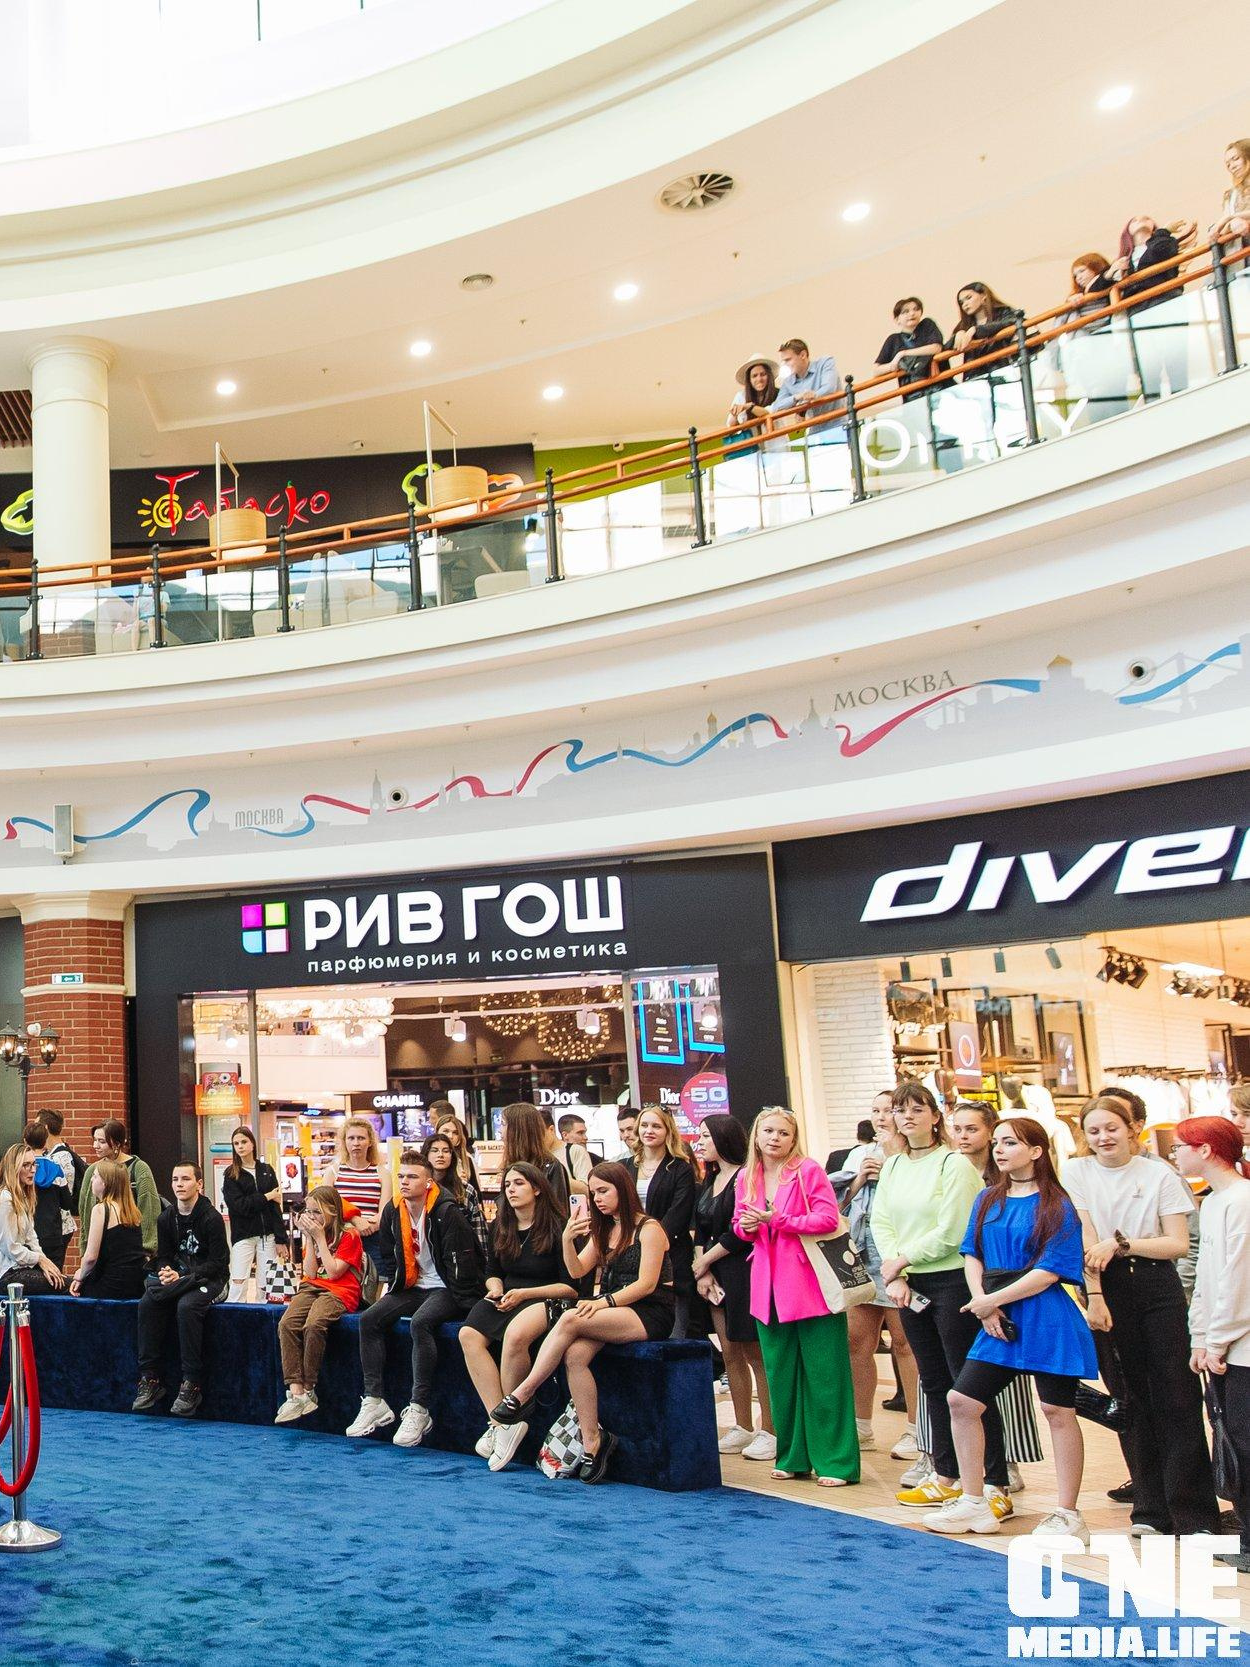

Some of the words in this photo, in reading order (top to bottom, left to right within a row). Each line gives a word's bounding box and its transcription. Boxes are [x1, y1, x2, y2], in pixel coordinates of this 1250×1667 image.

[833, 669, 957, 712] МОСКВА
[234, 807, 284, 828] МОСКВА
[859, 825, 1250, 922] dive
[304, 889, 445, 951] РИВ
[461, 875, 624, 941] ГОШ
[306, 951, 458, 974] парфюмерия
[467, 951, 481, 964] и
[490, 942, 629, 962] косметика
[372, 1093, 424, 1108] CHANEL
[539, 1087, 580, 1106] Dior
[659, 1087, 681, 1105] Dior
